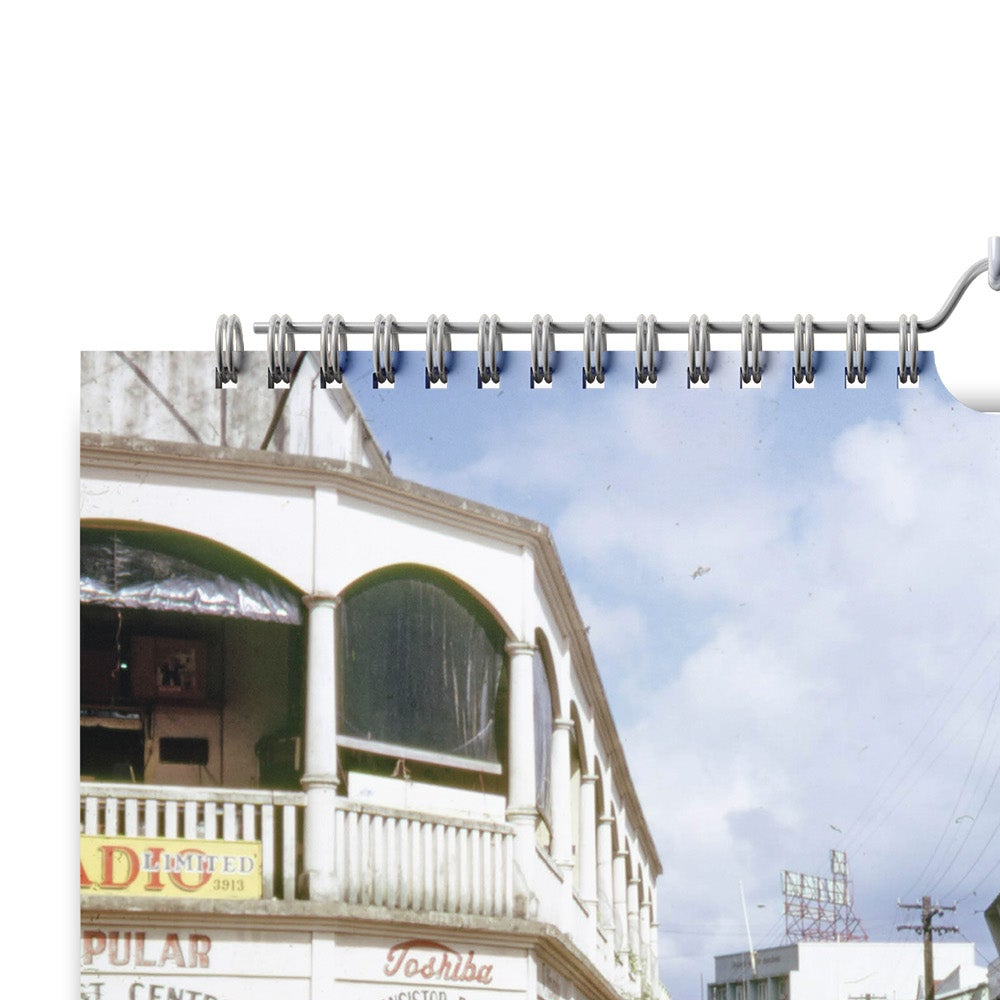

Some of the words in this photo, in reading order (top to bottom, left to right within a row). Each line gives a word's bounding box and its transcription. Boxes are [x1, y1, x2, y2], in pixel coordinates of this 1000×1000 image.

[143, 853, 255, 873] LIMITED
[213, 879, 245, 892] 3913
[82, 930, 213, 969] PULAR
[383, 939, 494, 985] Toshiba
